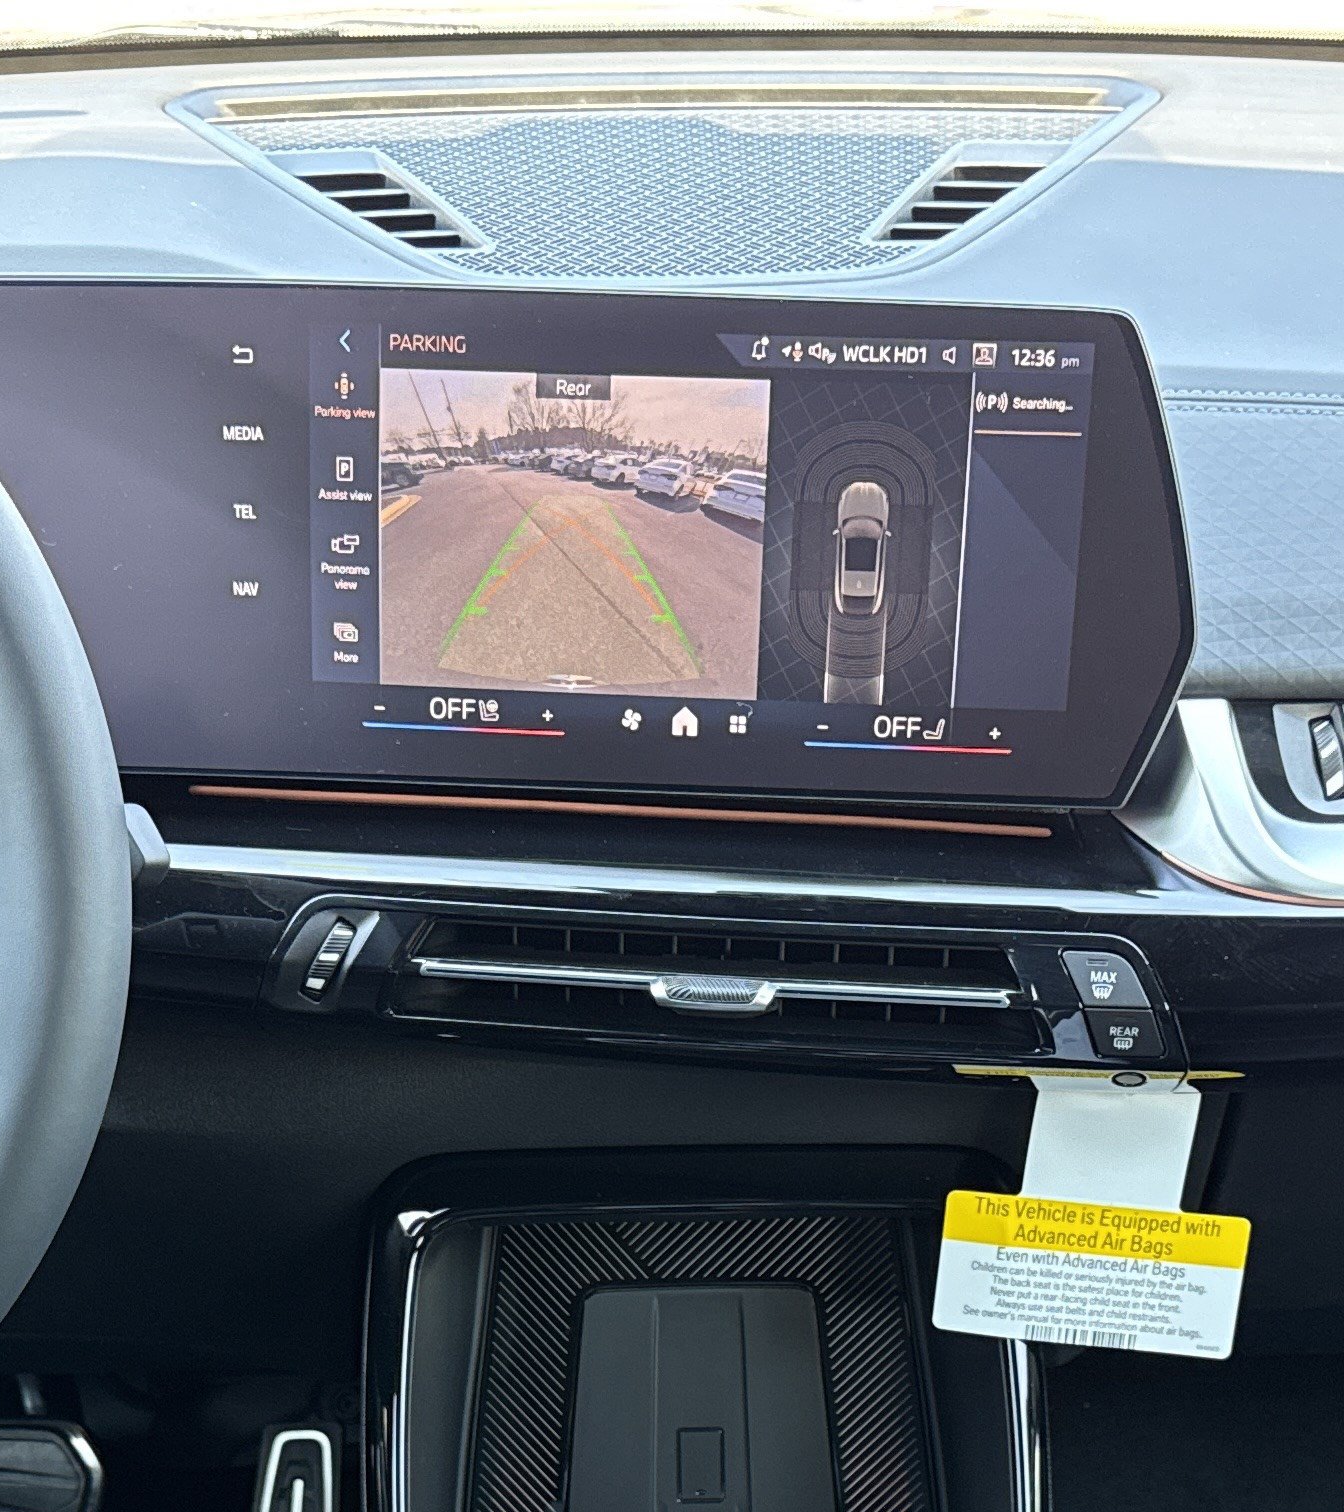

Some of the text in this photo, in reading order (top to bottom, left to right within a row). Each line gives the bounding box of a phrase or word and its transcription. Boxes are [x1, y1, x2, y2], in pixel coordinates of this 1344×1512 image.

[389, 333, 466, 354] PARKING
[842, 344, 927, 364] WCLK HD1
[1011, 348, 1080, 369] 12:36 pm
[556, 379, 592, 396] Rear
[314, 405, 376, 420] Parking view
[222, 425, 264, 441] MEDIA
[318, 488, 372, 502] Assist view
[233, 504, 257, 519] TEL
[320, 562, 370, 576] Panorama
[232, 581, 259, 597] NAV
[334, 578, 358, 590] view
[333, 650, 359, 664] More
[429, 696, 476, 720] OFF
[873, 715, 922, 739] OFF
[1090, 970, 1117, 984] MAX
[1109, 1025, 1140, 1037] REAR
[975, 1195, 1221, 1237] This Vehicle is Equipped with
[1013, 1224, 1174, 1259] Advanced Air Bags
[996, 1247, 1186, 1280] Even with Advanced Air Bags
[971, 1260, 1206, 1295] Children can be killed or seriously injured by the air bag.
[992, 1275, 1183, 1302] The back seat is the safest place for children.
[990, 1286, 1181, 1314] Never put a rear-facing child seat in the front.
[995, 1299, 1172, 1324] Always use seat belts and child restraints.
[962, 1305, 1203, 1340] See owner's manual for more information about air bags.
